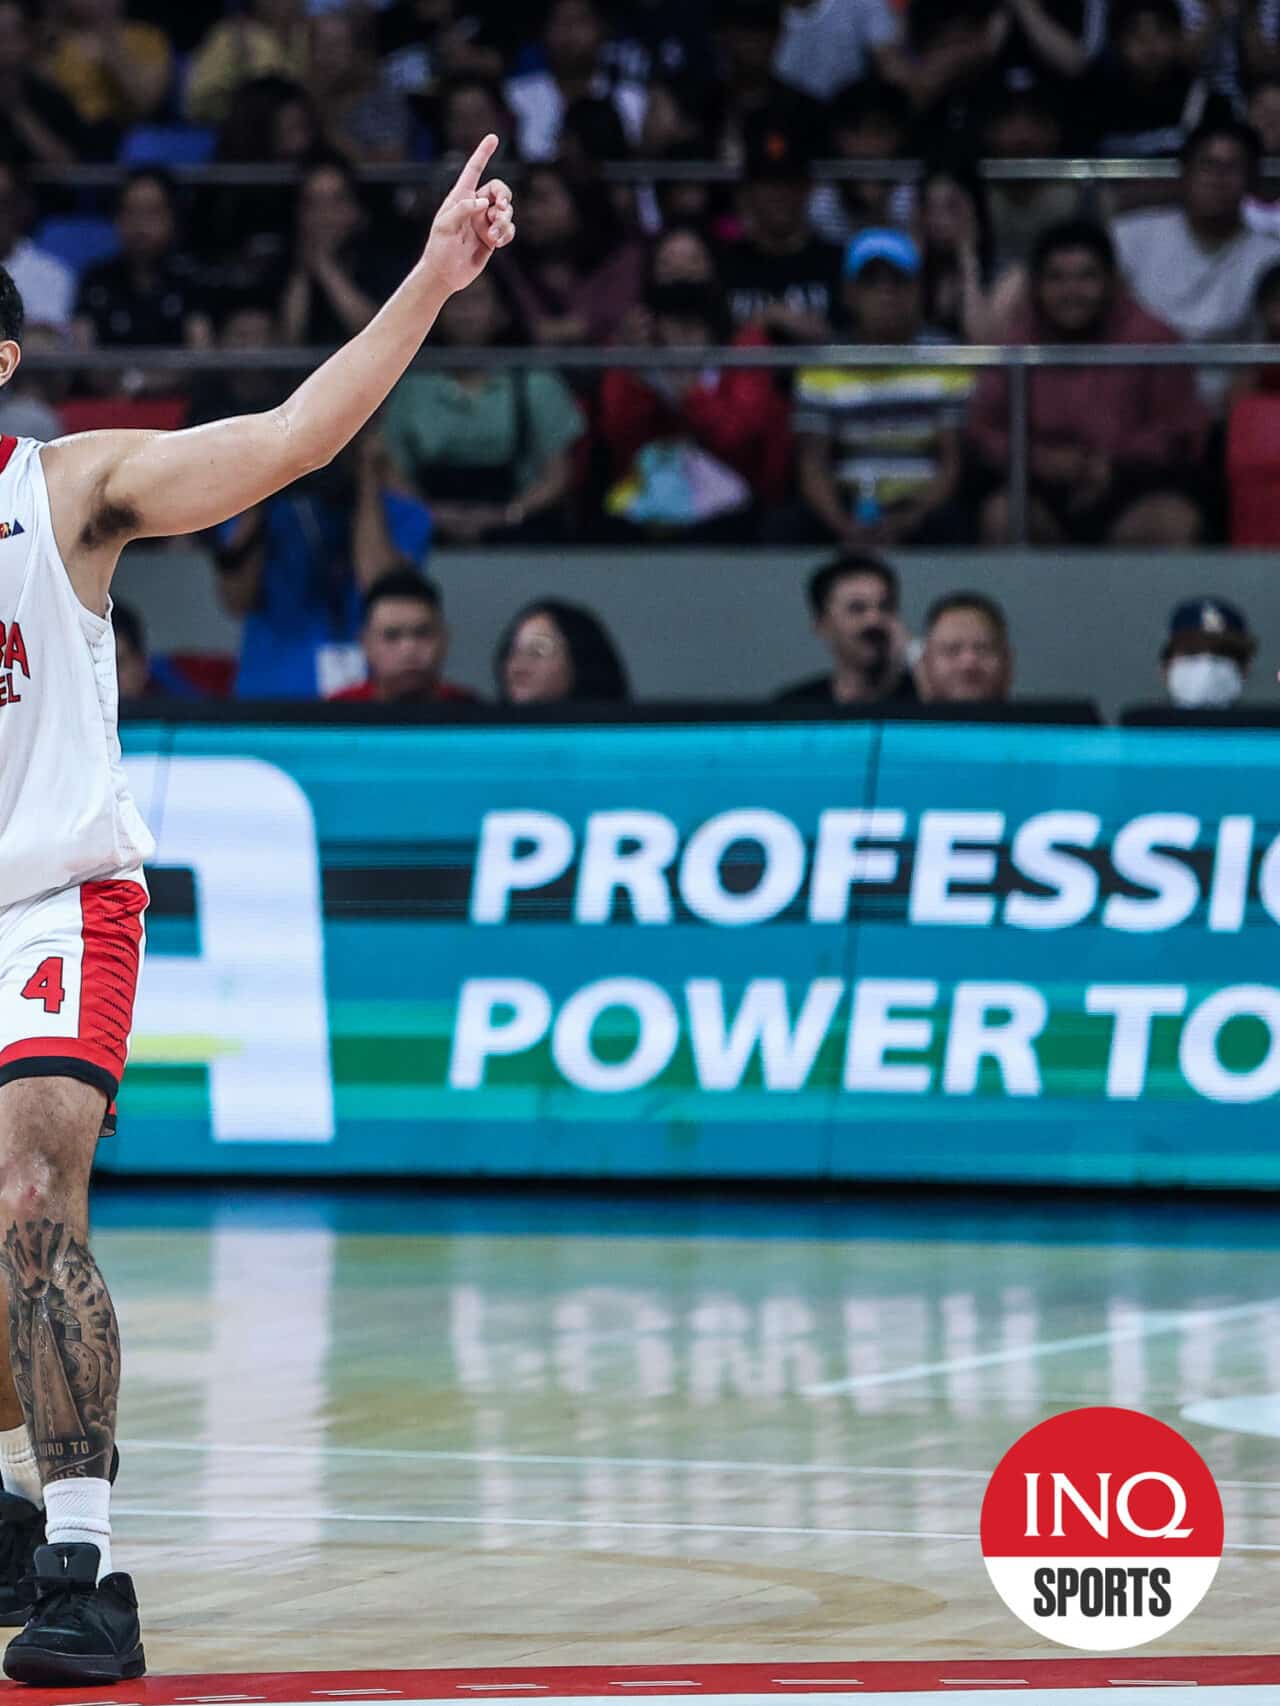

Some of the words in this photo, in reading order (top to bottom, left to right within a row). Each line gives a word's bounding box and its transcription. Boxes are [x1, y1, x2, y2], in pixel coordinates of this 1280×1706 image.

[470, 806, 1280, 933] PROFESSI
[20, 956, 65, 1014] 4
[447, 976, 1048, 1099] POWER
